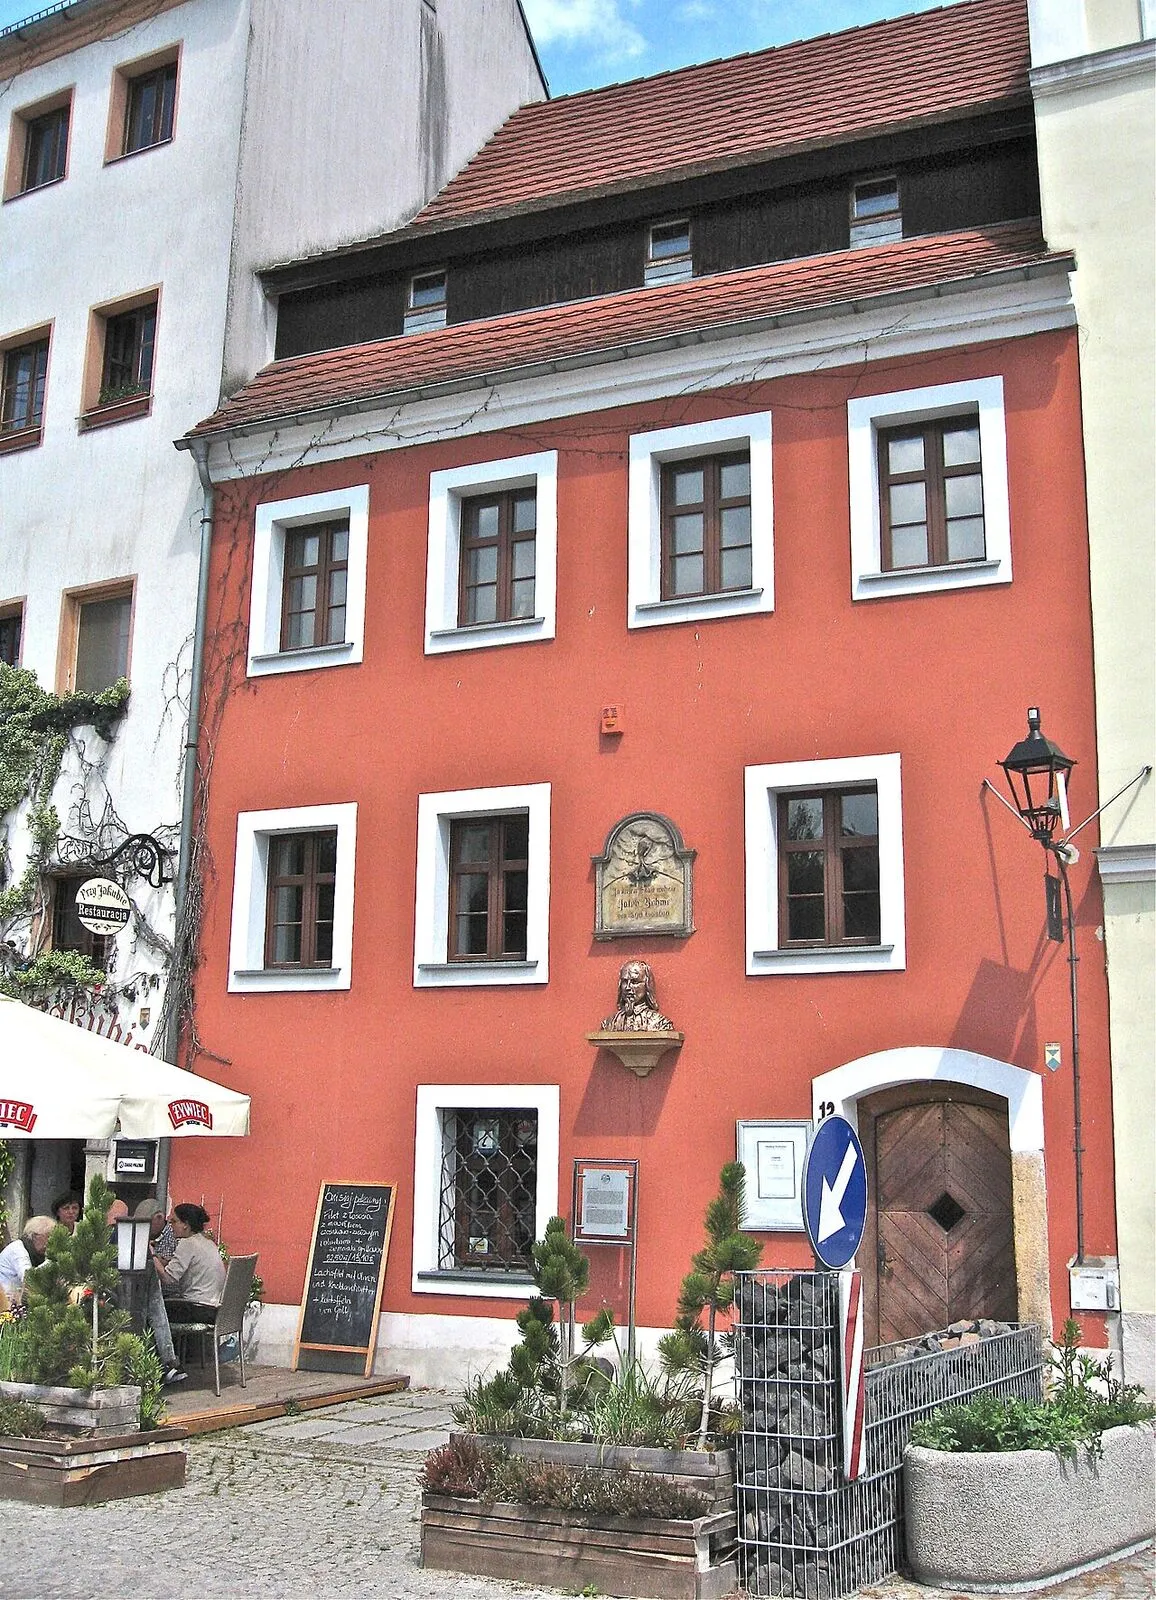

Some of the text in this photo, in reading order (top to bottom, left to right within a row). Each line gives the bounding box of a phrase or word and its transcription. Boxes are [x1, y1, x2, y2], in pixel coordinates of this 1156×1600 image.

[78, 903, 127, 921] Restauracja
[171, 1102, 208, 1121] ŻYWIEC
[818, 1101, 835, 1119] 12
